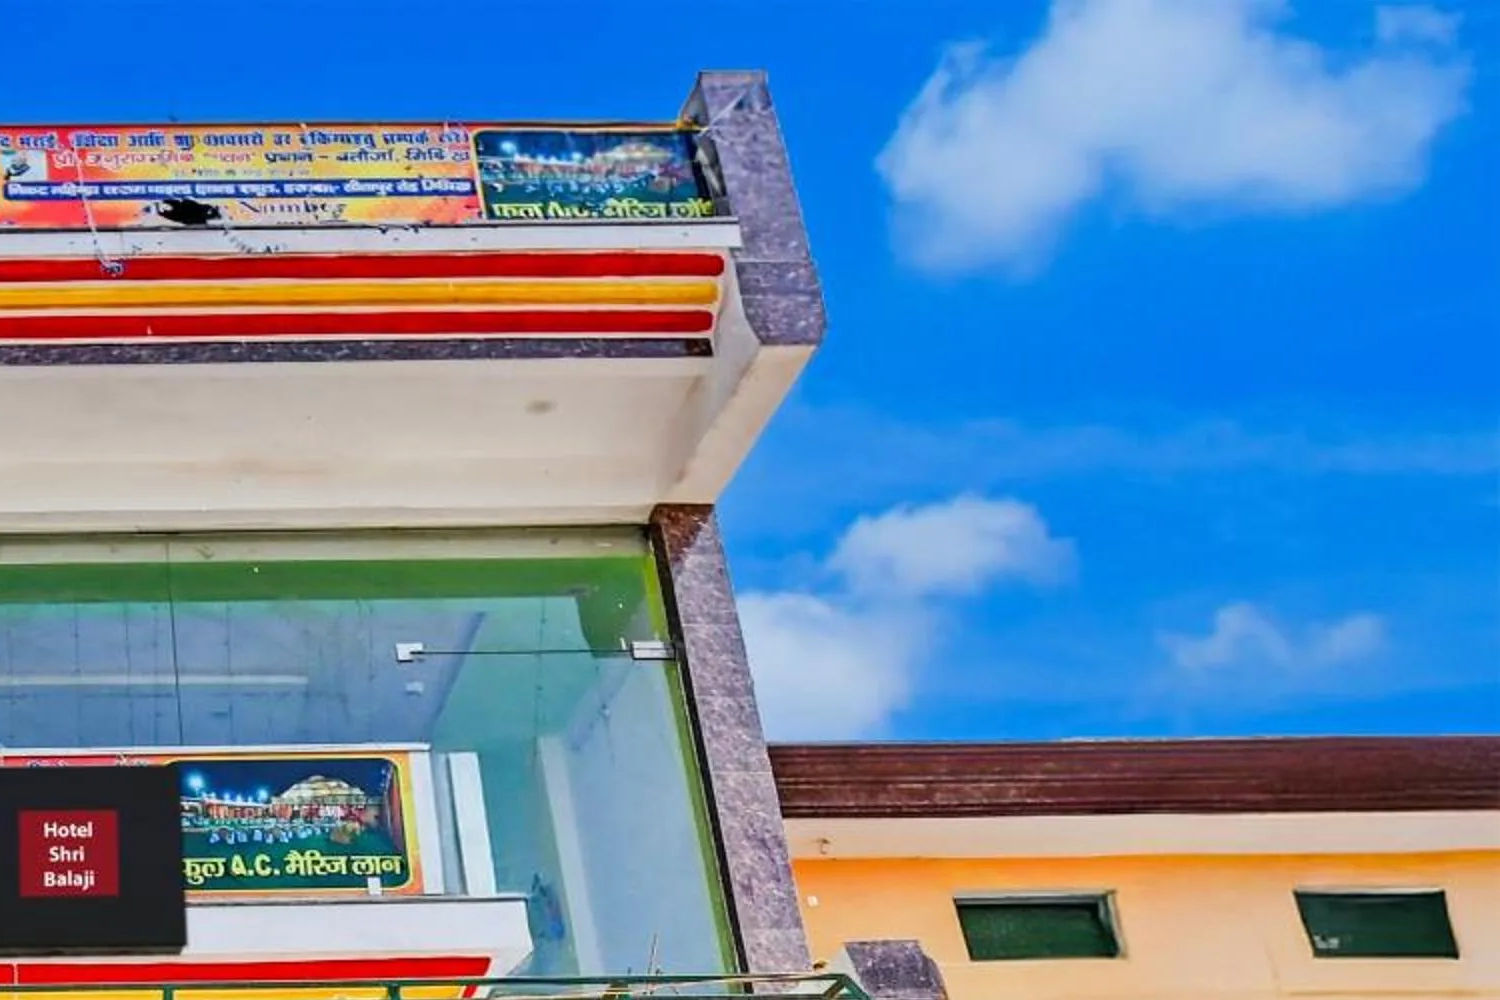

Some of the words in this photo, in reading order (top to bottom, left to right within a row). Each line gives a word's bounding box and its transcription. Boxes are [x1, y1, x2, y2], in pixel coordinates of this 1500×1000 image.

[43, 821, 93, 838] Hotel
[49, 845, 85, 863] Shri
[231, 853, 281, 877] A.C.
[284, 850, 348, 877] मैरिज
[43, 869, 95, 890] Balaji
